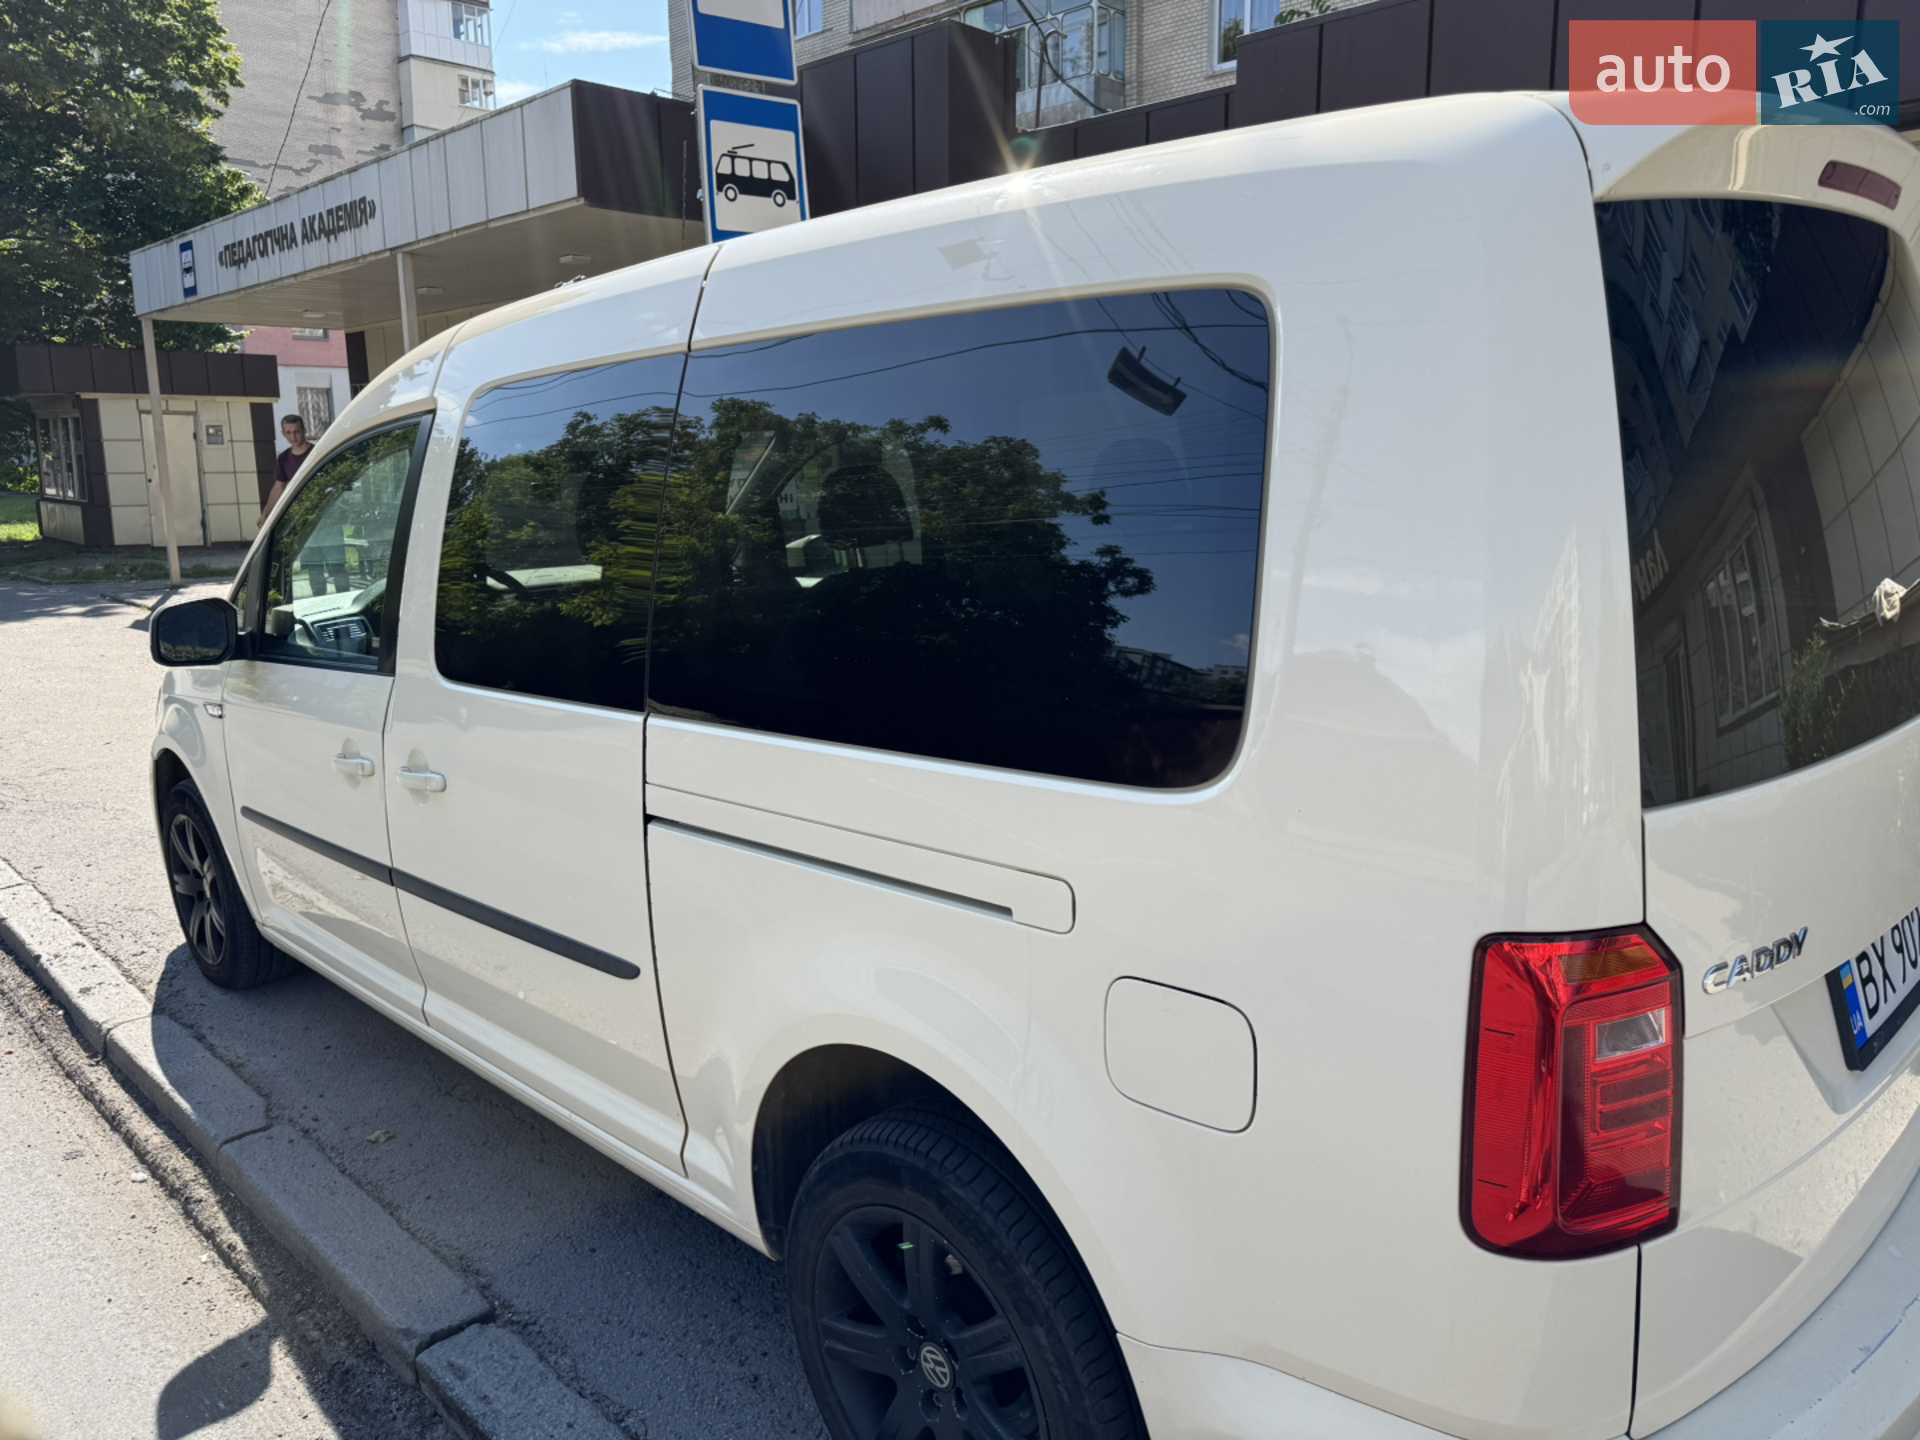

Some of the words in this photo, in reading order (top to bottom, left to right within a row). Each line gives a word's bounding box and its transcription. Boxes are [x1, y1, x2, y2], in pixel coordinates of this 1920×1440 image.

[218, 221, 298, 269] «ПЕДАГОГІЧНА
[302, 196, 377, 243] АКАДЕМІЯ»
[1702, 926, 1808, 995] CADDY
[1855, 935, 1897, 1021] BX
[1850, 1010, 1864, 1034] UA
